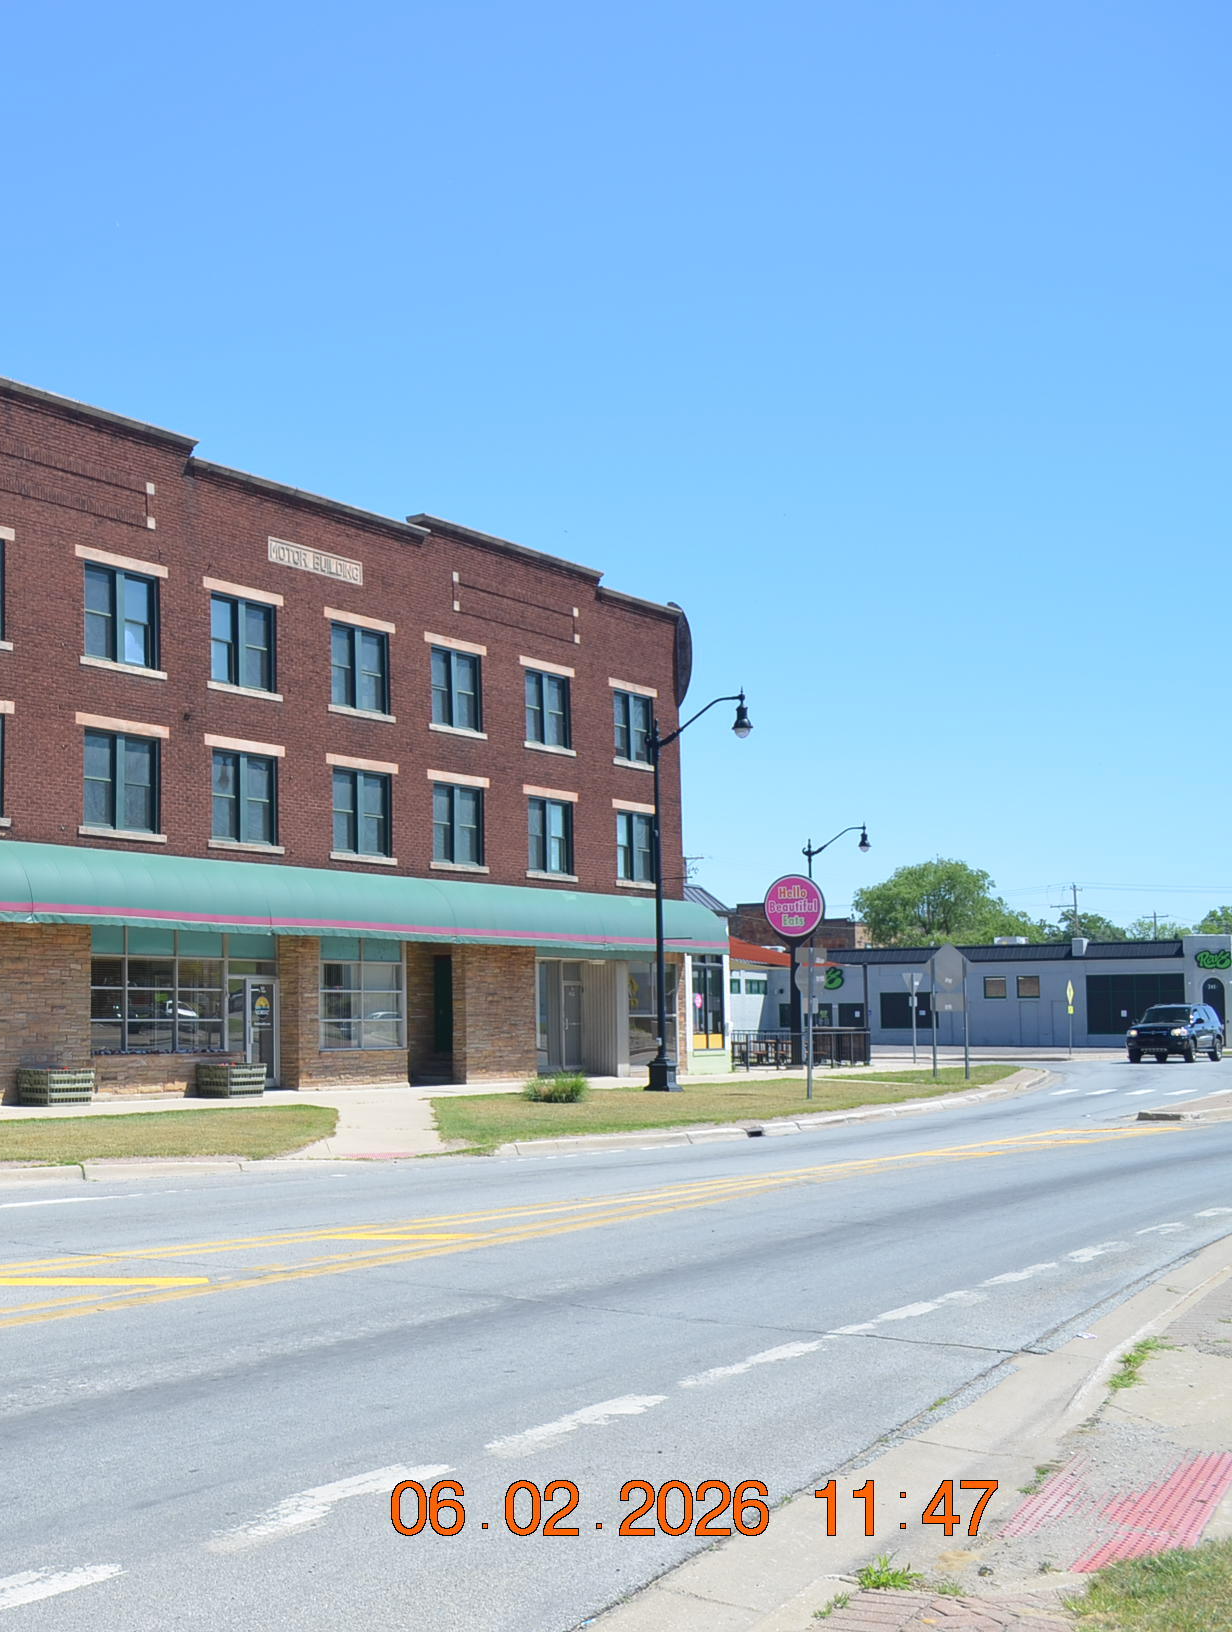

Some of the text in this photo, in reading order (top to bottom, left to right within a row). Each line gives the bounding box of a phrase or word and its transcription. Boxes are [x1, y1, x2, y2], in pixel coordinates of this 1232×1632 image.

[270, 542, 359, 581] MOTOR BUILDING
[778, 885, 807, 899] Hello
[768, 899, 818, 913] Beautiful
[782, 914, 805, 927] Eats
